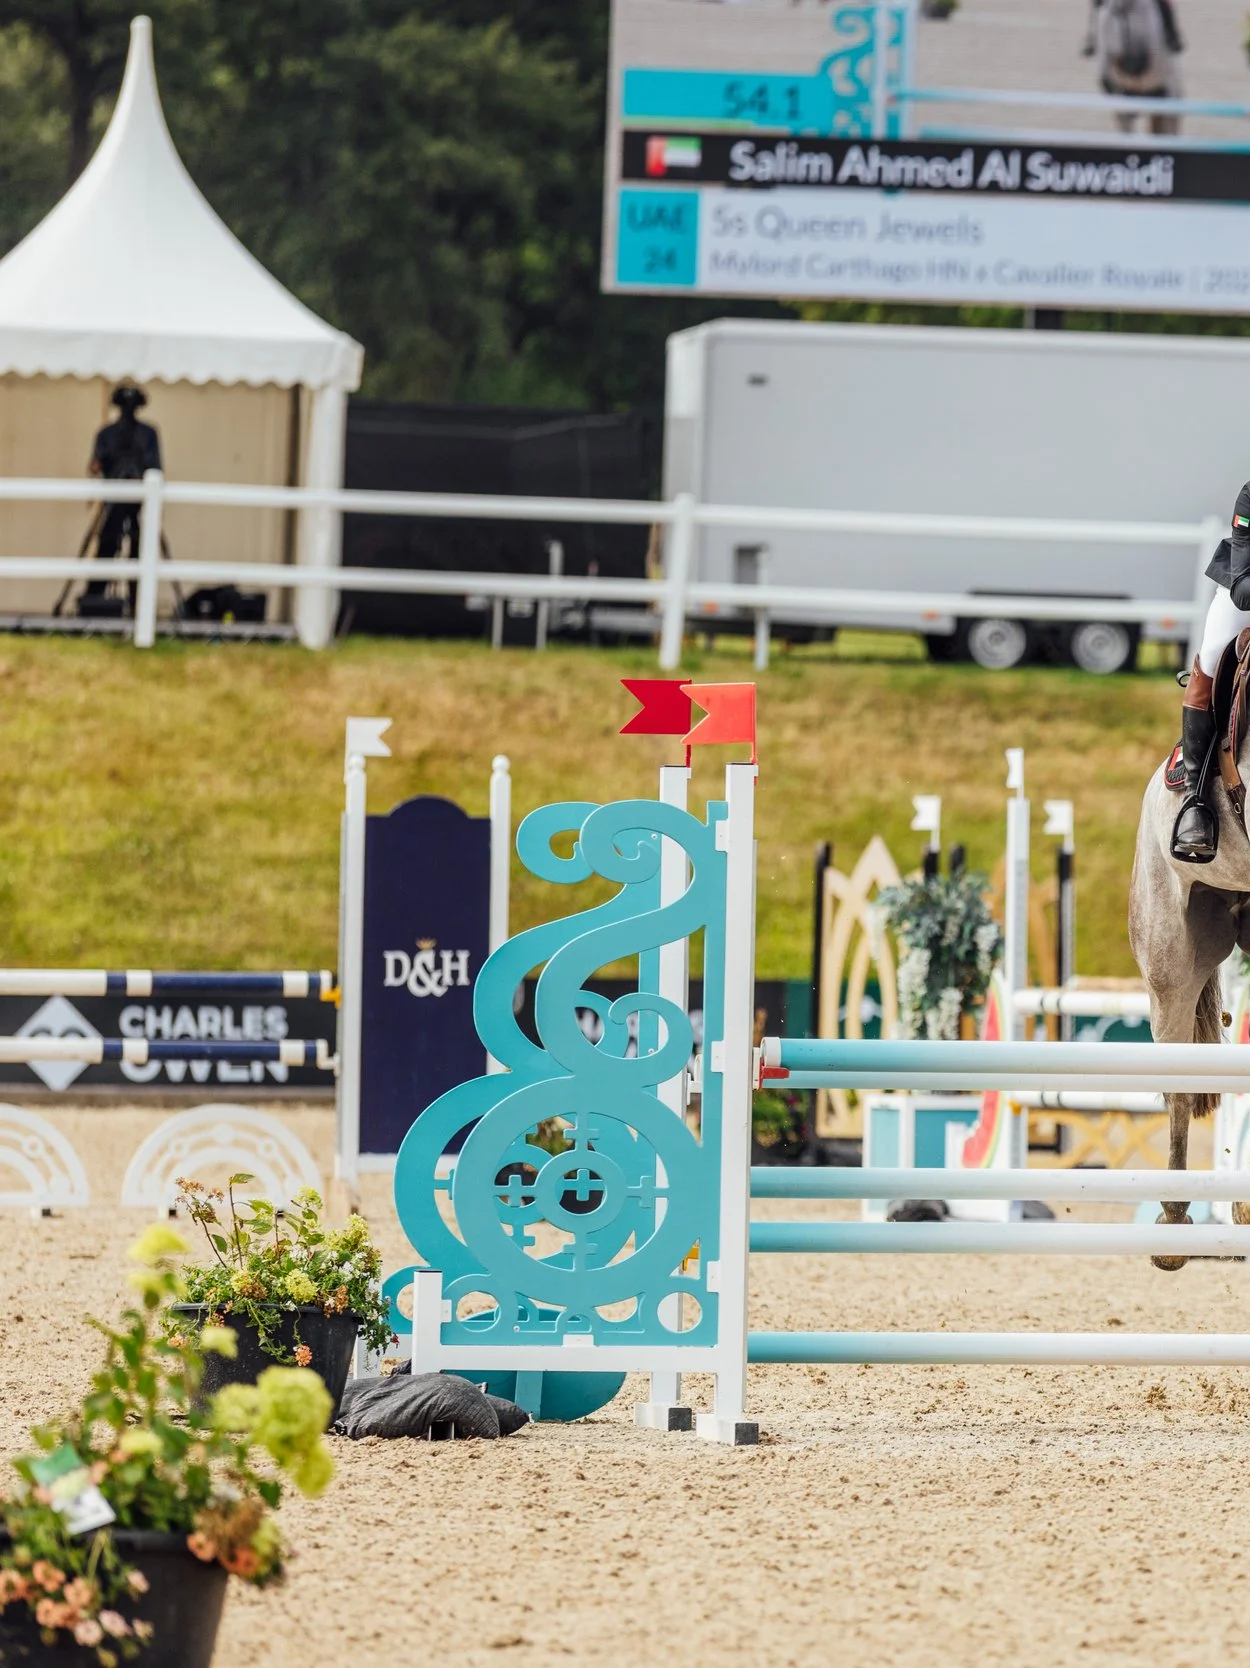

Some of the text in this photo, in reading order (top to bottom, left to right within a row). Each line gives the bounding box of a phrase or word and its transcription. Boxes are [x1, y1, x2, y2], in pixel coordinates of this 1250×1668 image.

[729, 140, 1174, 196] Salim Ahmed Al Suwaidi
[626, 201, 687, 234] UAE
[754, 204, 869, 245] Queen
[874, 208, 986, 248] Jewels
[383, 949, 470, 997] D&H
[119, 1005, 289, 1040] CHARLES
